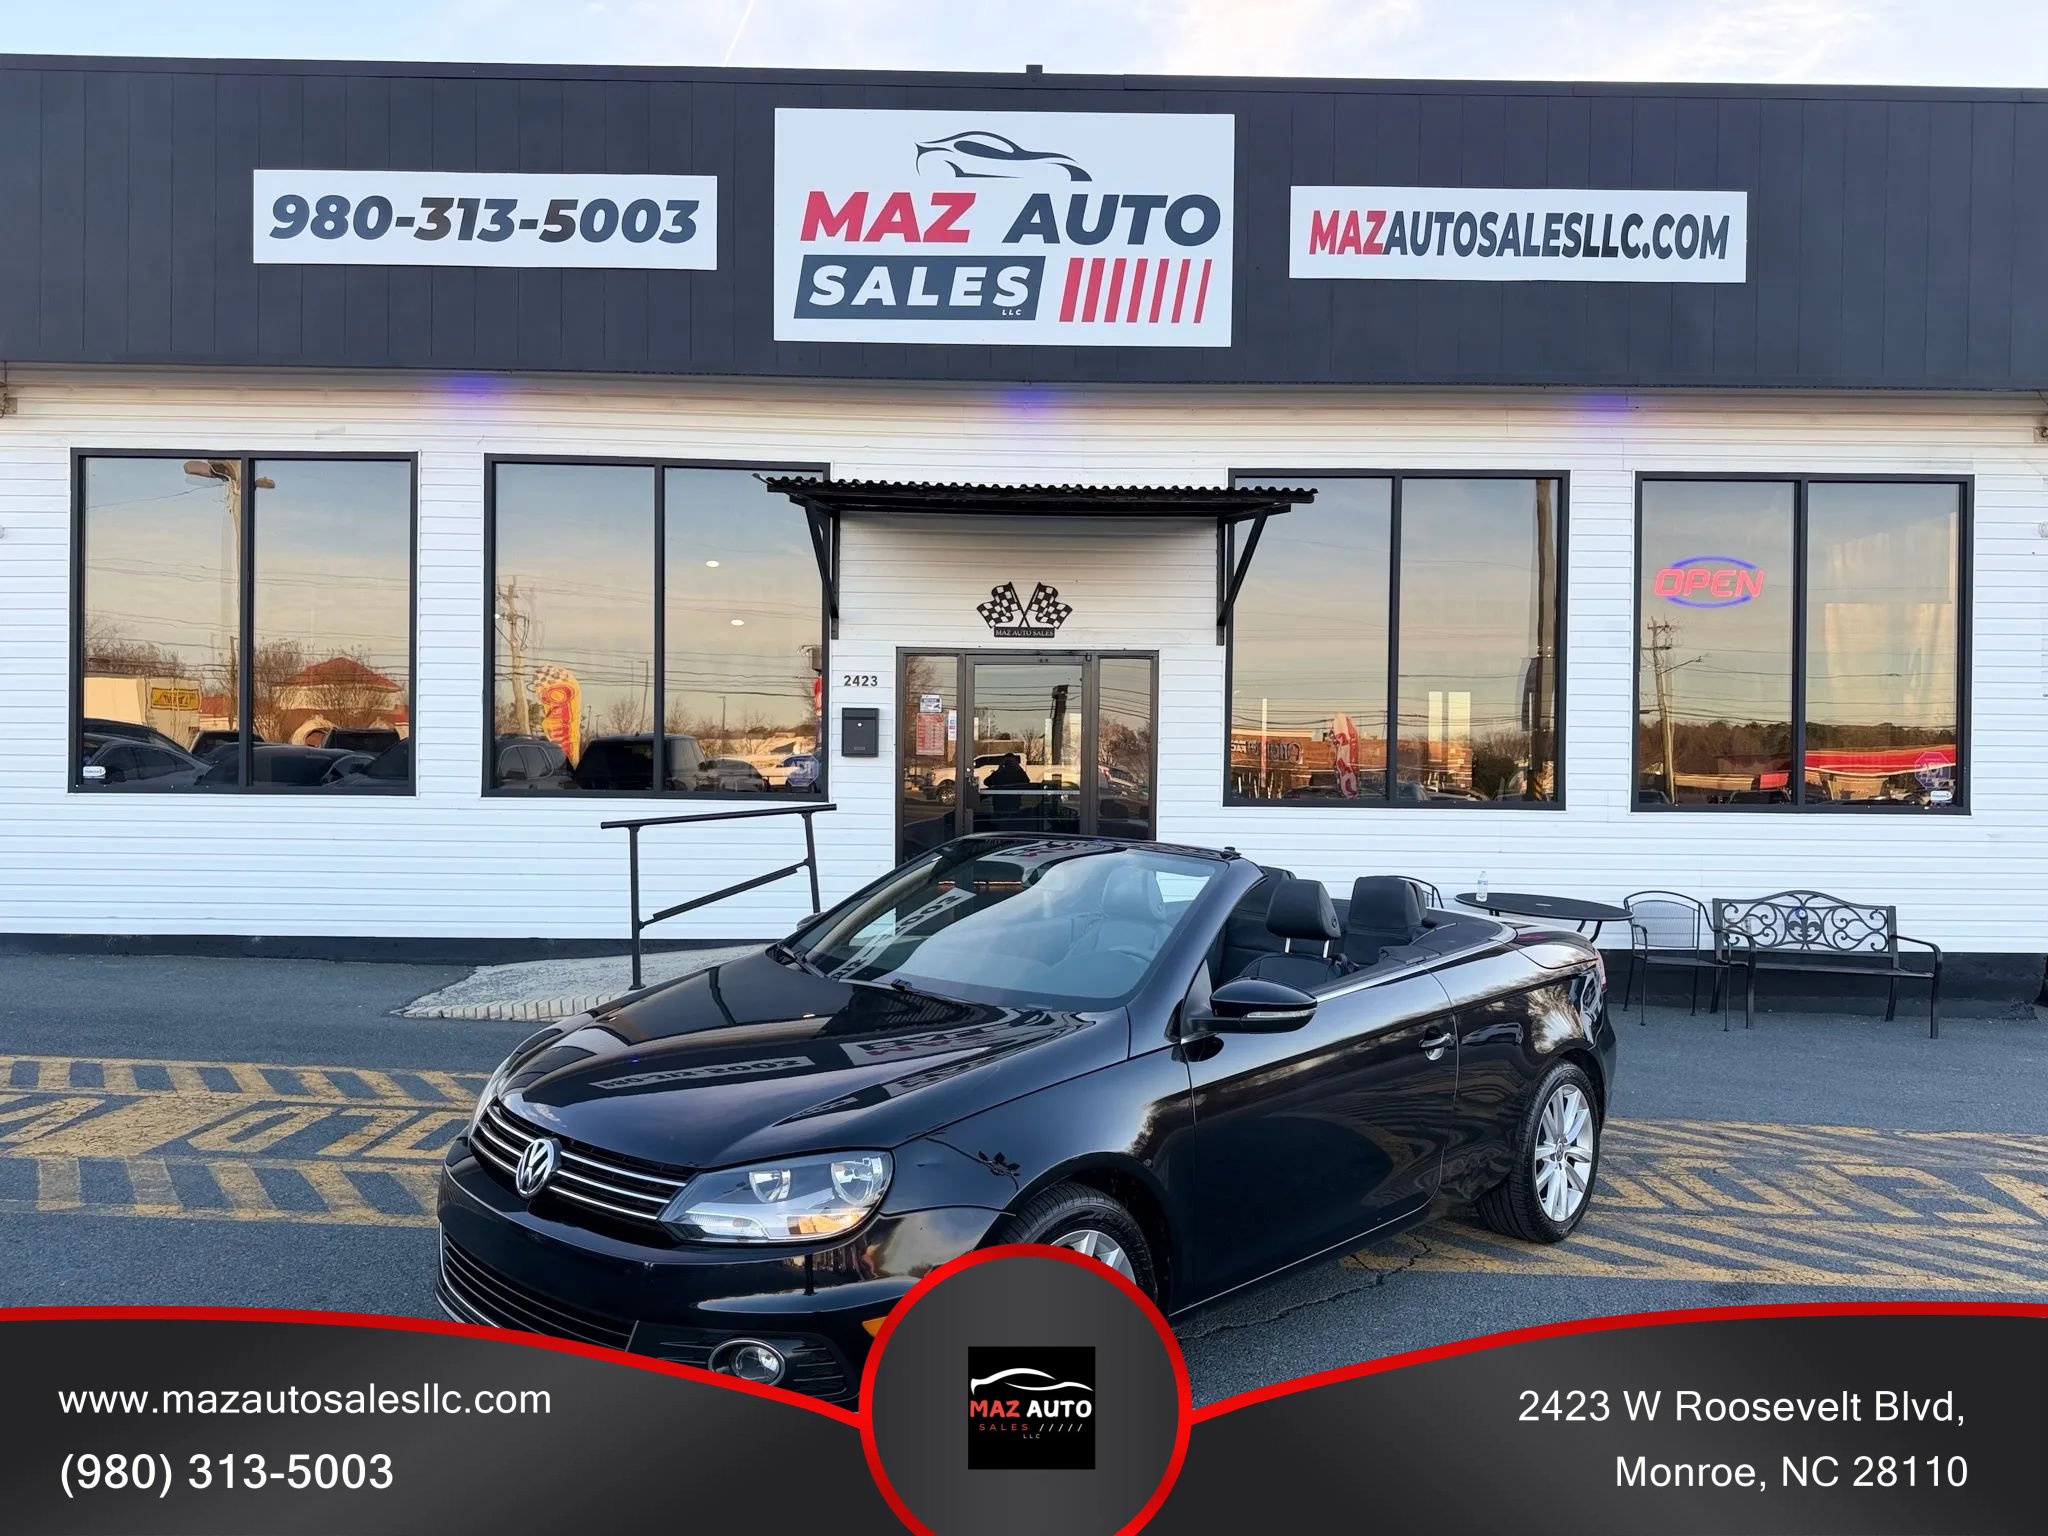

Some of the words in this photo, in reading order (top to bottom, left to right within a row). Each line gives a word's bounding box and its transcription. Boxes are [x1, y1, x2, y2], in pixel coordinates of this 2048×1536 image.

[270, 195, 699, 244] 980-313-5003
[800, 191, 976, 243] MAZ
[1002, 194, 1221, 247] AUTO
[1309, 210, 1729, 260] MAZAUTOSALESLLC.COM
[808, 264, 1031, 309] SALES
[1654, 568, 1765, 598] OPEN
[995, 629, 1012, 637] MAZ
[1012, 629, 1032, 637] AUTO
[1032, 629, 1055, 637] SALES
[843, 674, 879, 687] 2423
